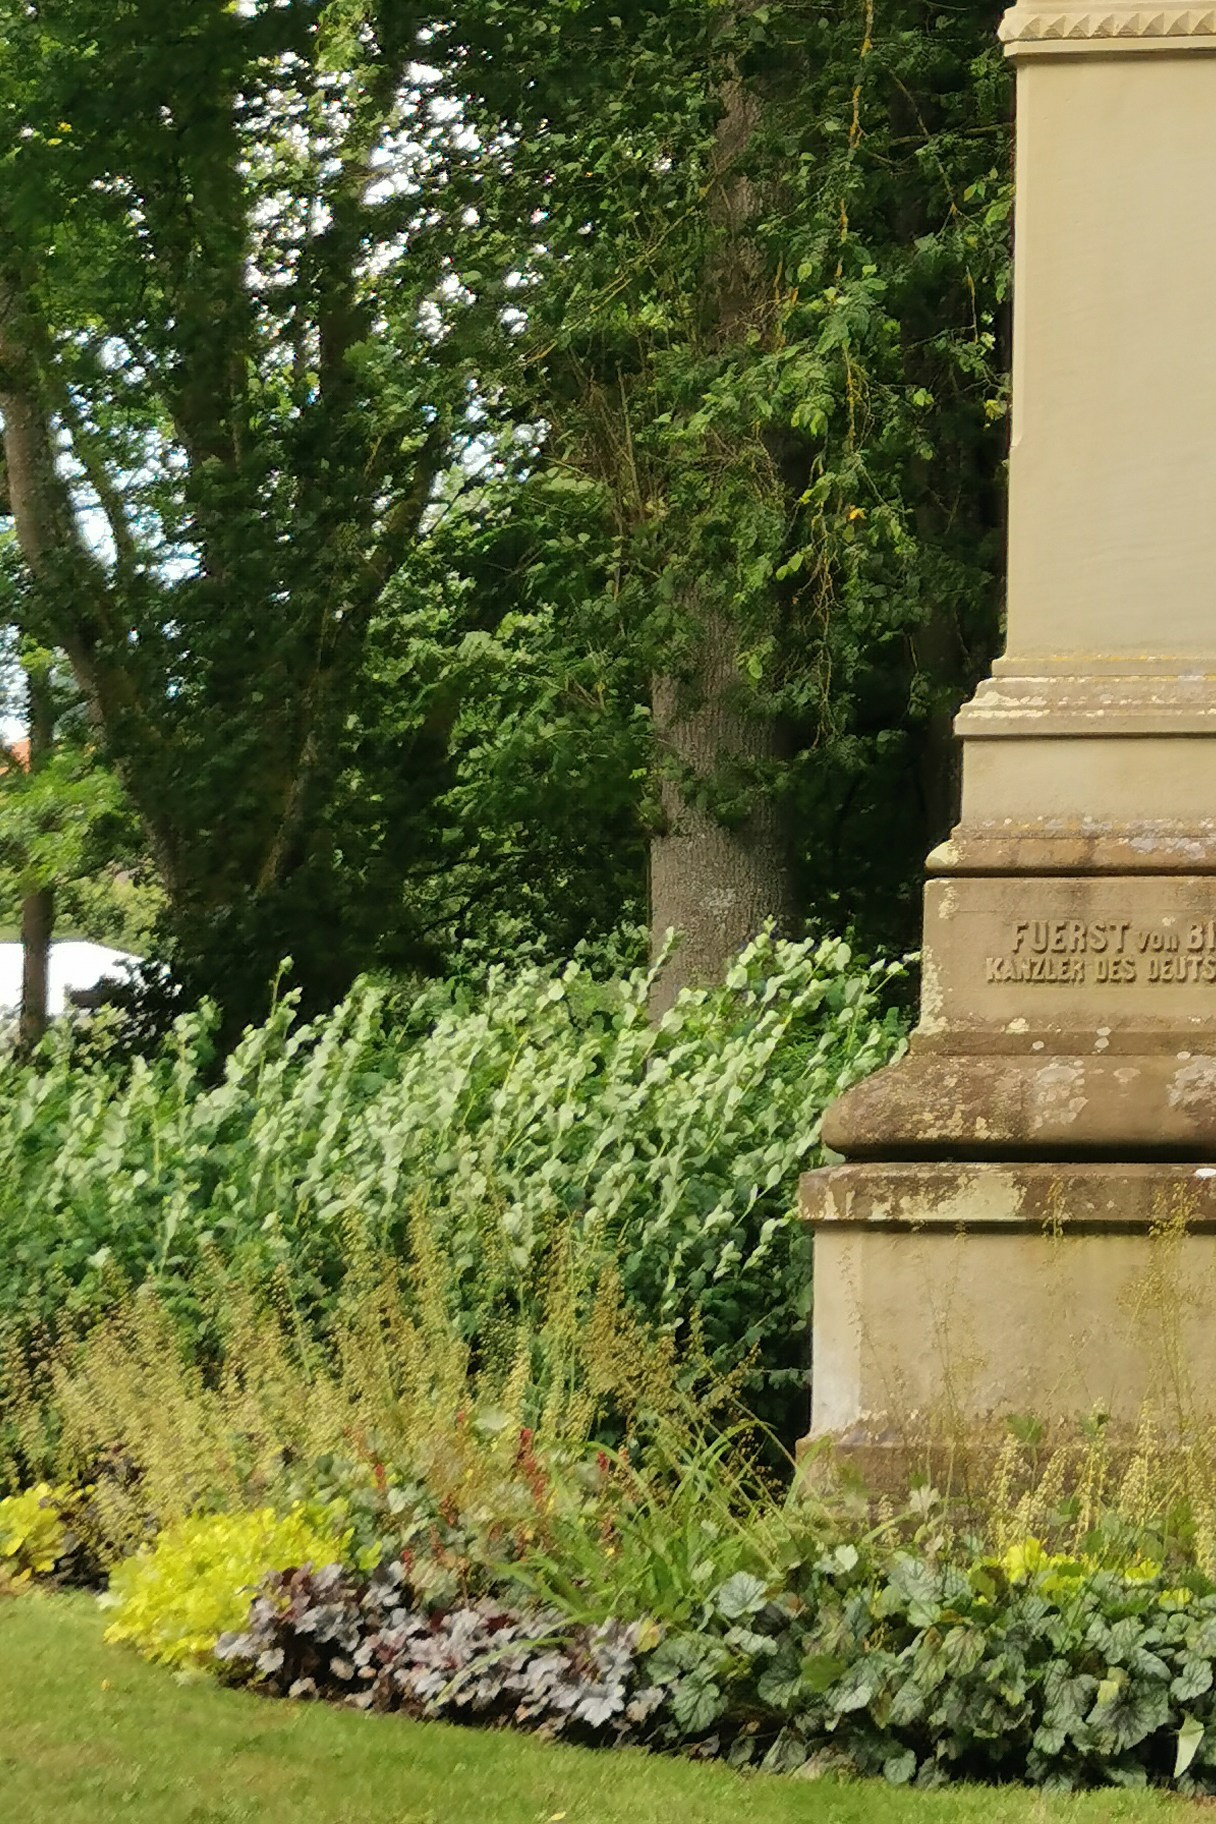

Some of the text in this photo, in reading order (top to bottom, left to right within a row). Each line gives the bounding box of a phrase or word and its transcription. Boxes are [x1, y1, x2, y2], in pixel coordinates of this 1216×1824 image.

[1012, 919, 1132, 953] FUERST
[1136, 931, 1180, 953] von
[986, 956, 1086, 984] KANZLER
[1096, 957, 1137, 983] DES
